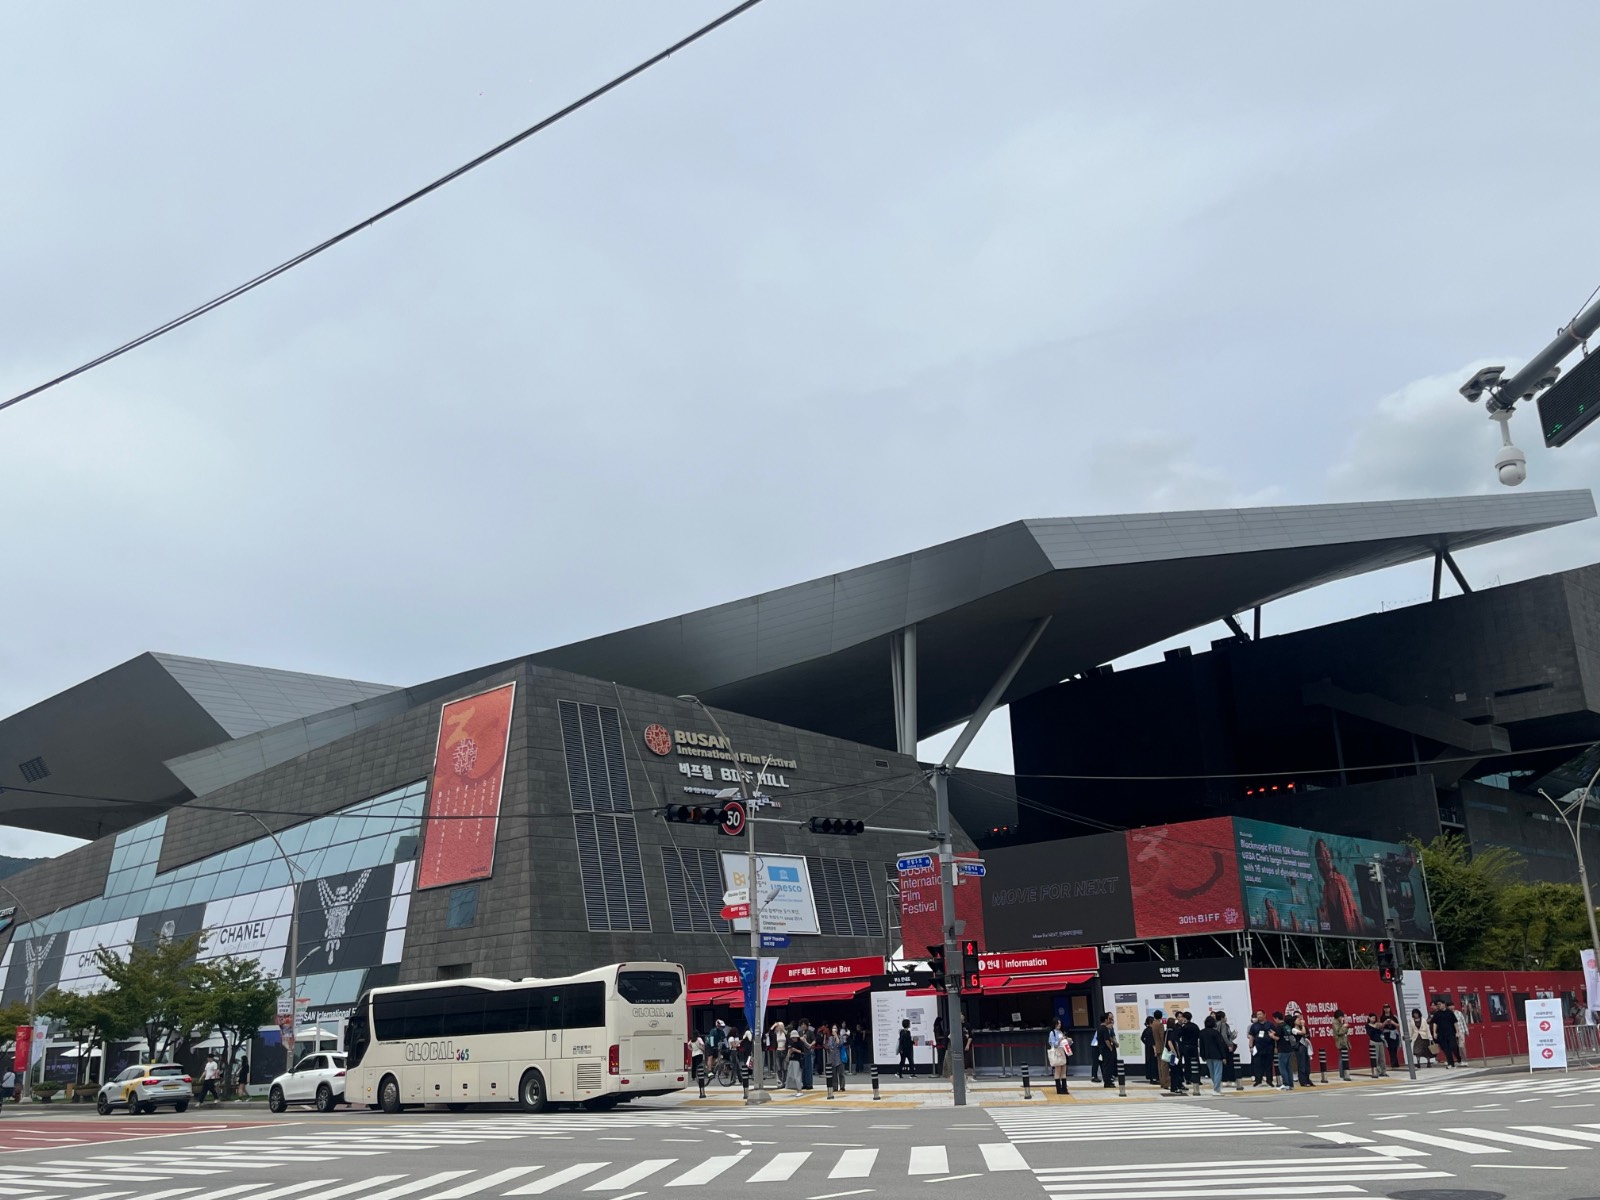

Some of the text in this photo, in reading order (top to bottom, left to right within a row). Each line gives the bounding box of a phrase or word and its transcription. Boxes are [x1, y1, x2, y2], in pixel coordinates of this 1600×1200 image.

[674, 730, 731, 749] BUSAN
[740, 753, 760, 766] Film
[726, 810, 741, 827] 50
[900, 875, 943, 890] Internatio
[901, 890, 921, 903] Film
[992, 876, 1119, 907] MOVE FOR NEXT
[902, 900, 938, 915] Festival
[1178, 913, 1221, 925] 30th BIFF
[220, 922, 266, 945] CHANEL
[987, 958, 1048, 970] 안내 Information
[788, 969, 801, 977] BIFF
[820, 966, 838, 975] Ticket
[839, 965, 852, 973] Box
[1385, 968, 1391, 979] 6
[971, 974, 978, 987] 6
[632, 1007, 666, 1019] GLOBAL
[1305, 1002, 1339, 1013] 30th BUSAN
[1354, 1025, 1367, 1036] 2025
[405, 1040, 471, 1062] GLOBAL 365
